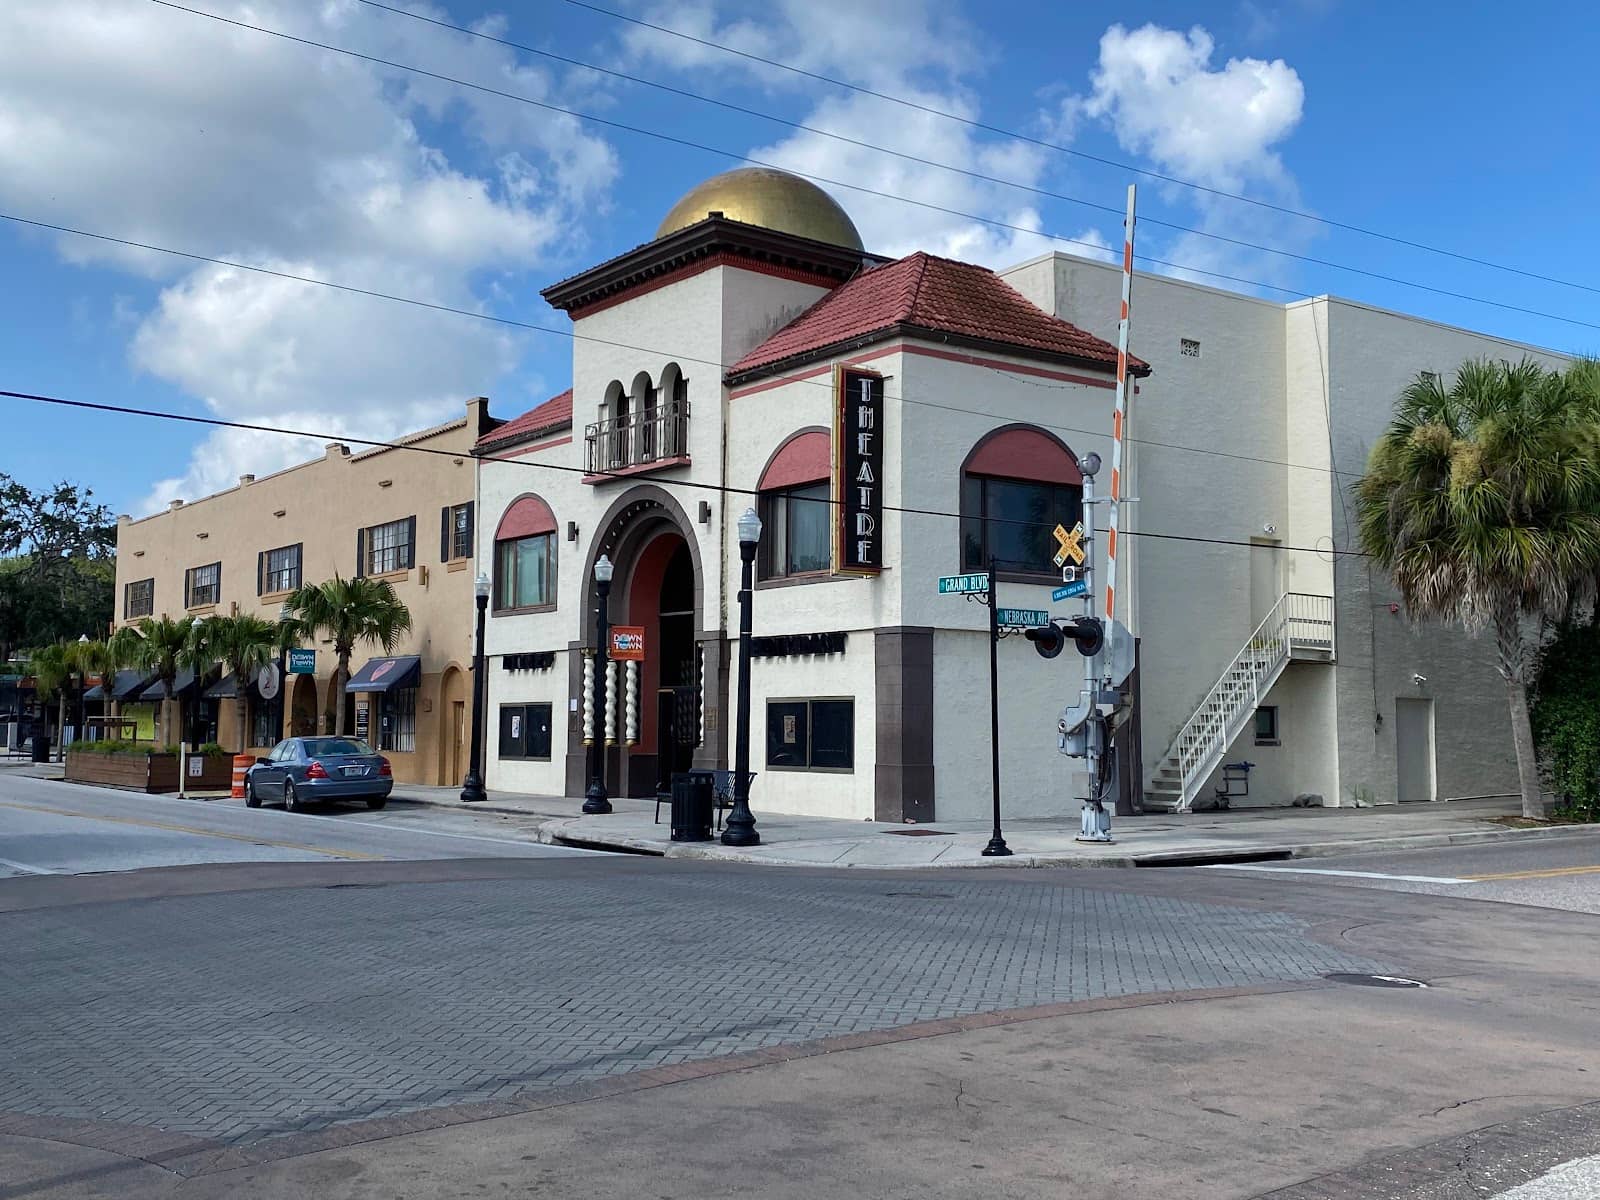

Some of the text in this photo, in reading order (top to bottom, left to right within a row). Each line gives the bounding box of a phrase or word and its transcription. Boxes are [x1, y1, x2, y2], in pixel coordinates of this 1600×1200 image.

[856, 378, 875, 564] THEATRE
[945, 575, 988, 592] GRAND BLVD
[1004, 609, 1048, 625] NEBRASKA AVE
[613, 633, 643, 642] DOWN
[613, 641, 643, 650] TOWN
